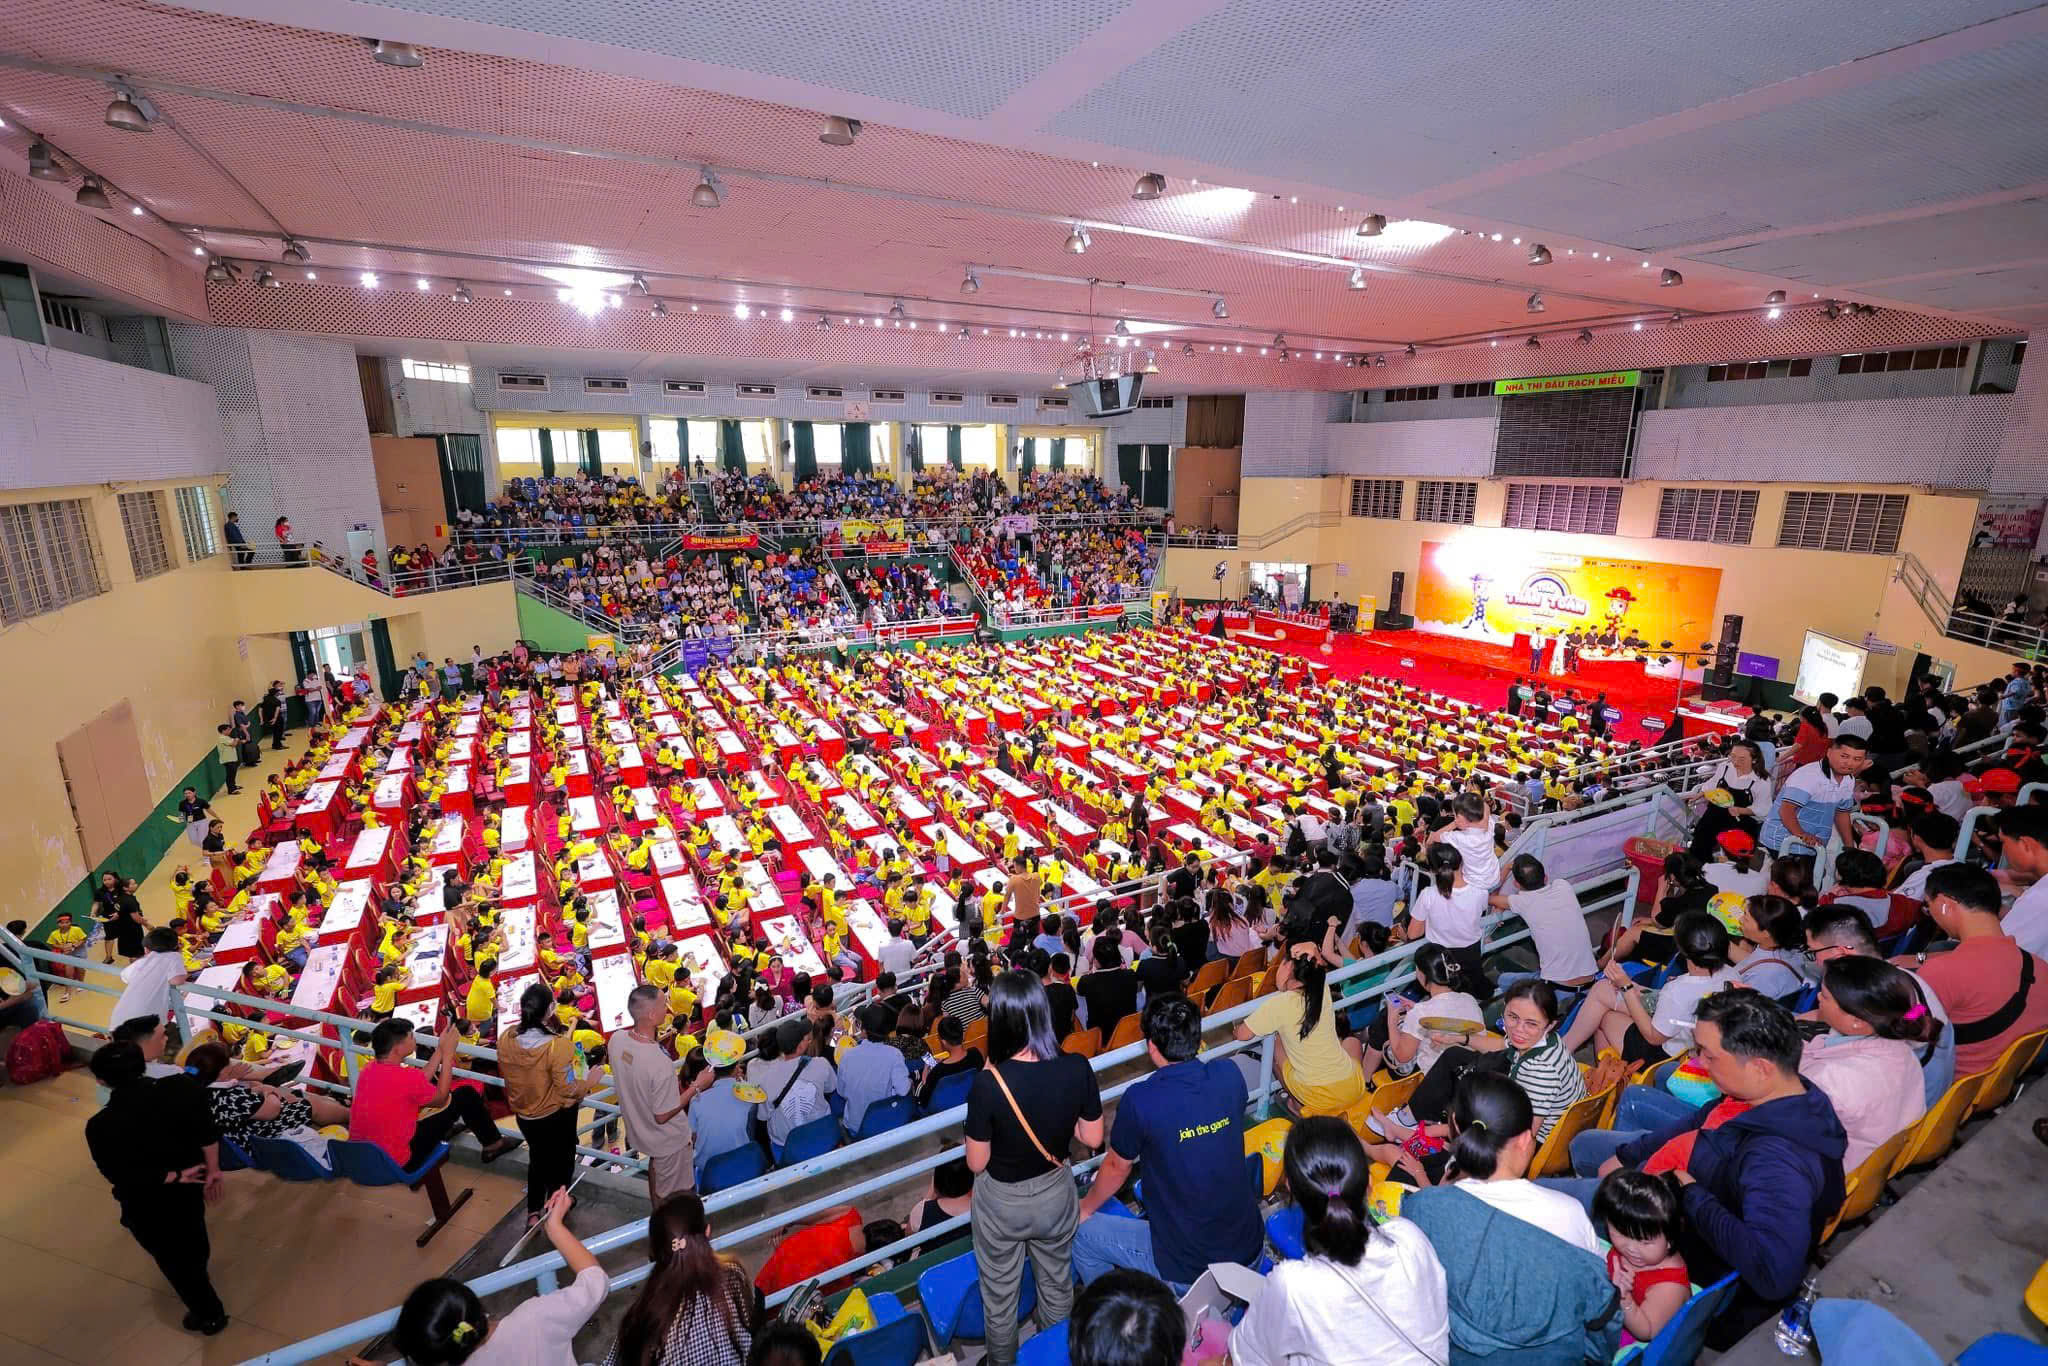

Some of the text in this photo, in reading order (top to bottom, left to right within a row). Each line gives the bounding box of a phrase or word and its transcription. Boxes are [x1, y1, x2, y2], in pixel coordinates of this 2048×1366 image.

[1527, 382, 1543, 390] THI
[1179, 1117, 1230, 1142] join the game
